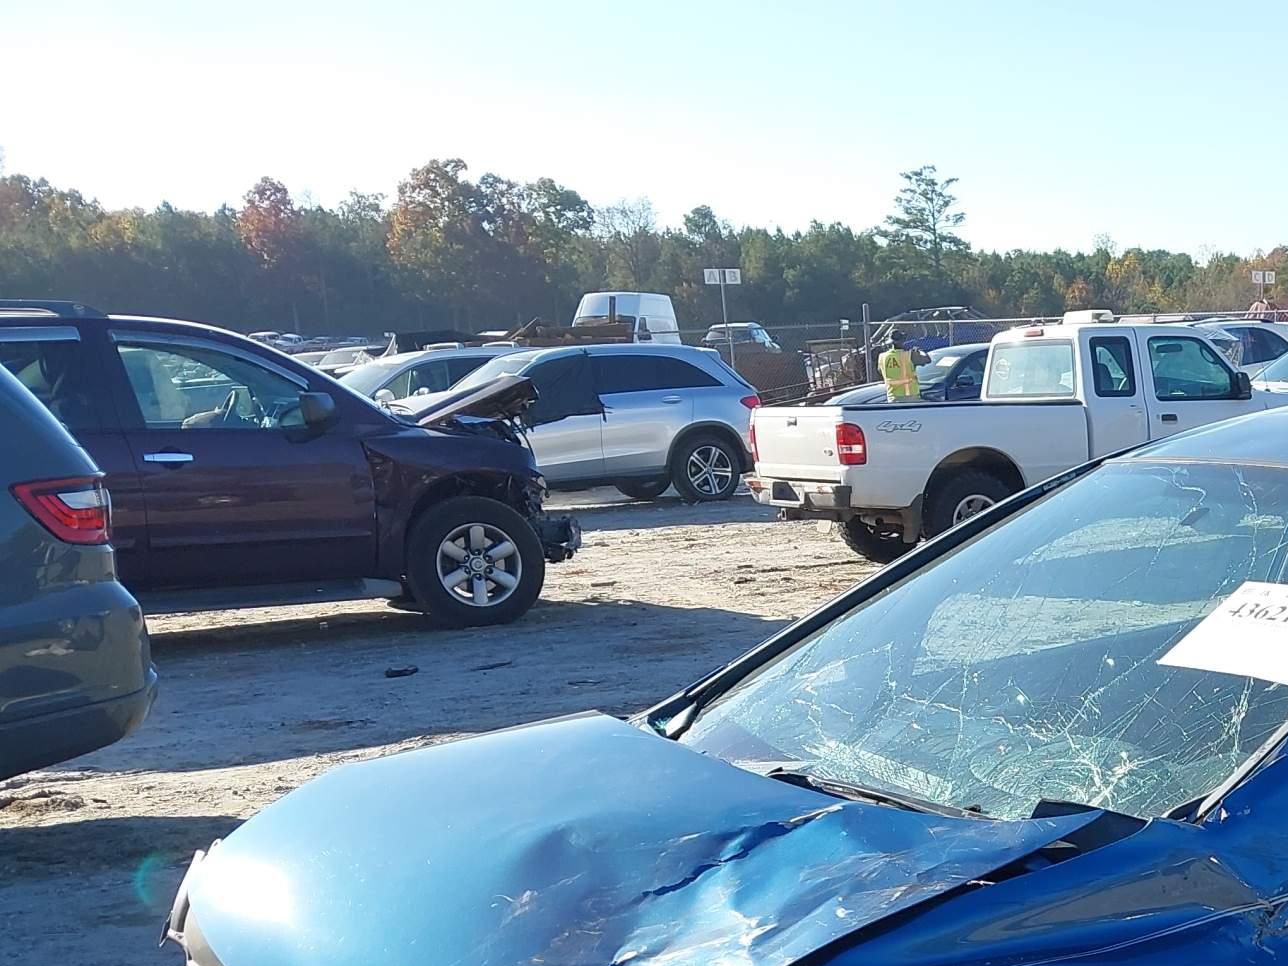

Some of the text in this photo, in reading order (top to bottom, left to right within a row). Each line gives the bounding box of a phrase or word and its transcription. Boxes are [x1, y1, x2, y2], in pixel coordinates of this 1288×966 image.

[706, 270, 718, 282] A
[727, 270, 737, 281] B
[876, 420, 922, 432] 4x4
